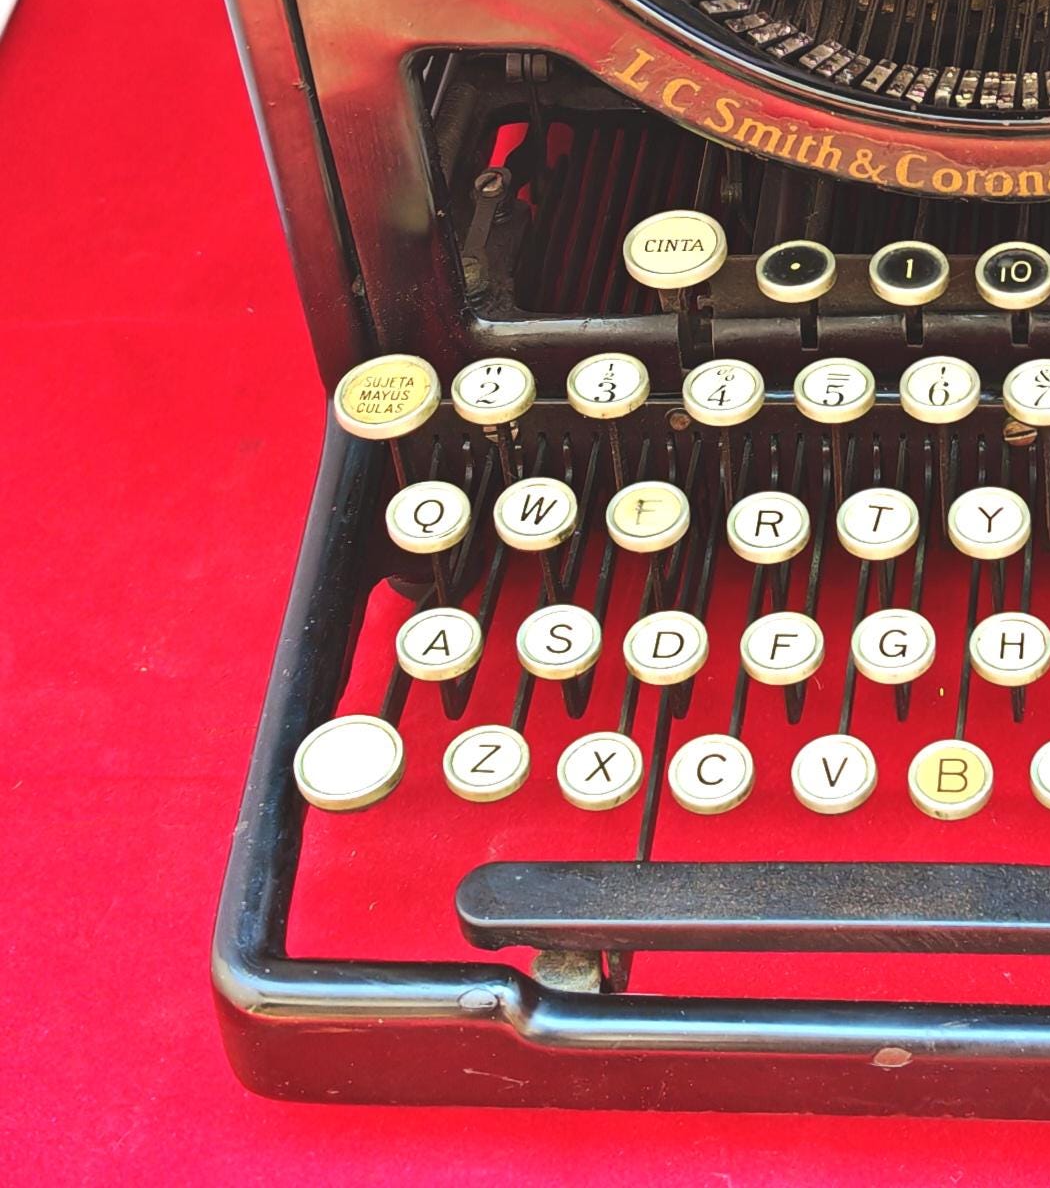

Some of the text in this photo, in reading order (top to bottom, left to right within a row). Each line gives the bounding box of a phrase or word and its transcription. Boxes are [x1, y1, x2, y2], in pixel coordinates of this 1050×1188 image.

[613, 47, 655, 93] L
[661, 77, 701, 113] C
[703, 97, 844, 173] Smith
[849, 148, 889, 186] &
[643, 238, 705, 254] CINTA
[904, 258, 914, 280] 1
[1000, 260, 1032, 283] 10
[359, 389, 411, 402] MAYUS
[364, 376, 415, 389] SUJETA
[475, 381, 500, 405] 2
[593, 381, 617, 404] 3
[707, 384, 732, 407] 4
[822, 384, 846, 406] 5
[927, 381, 950, 407] 6
[356, 402, 405, 414] CULAS
[413, 499, 445, 534] Q
[520, 493, 558, 526] W
[754, 509, 784, 538] R
[868, 504, 894, 533] T
[978, 506, 1004, 534] Y
[422, 629, 450, 657] A
[545, 623, 573, 654] S
[652, 631, 685, 659] D
[769, 633, 799, 661] F
[878, 629, 908, 658] G
[1000, 632, 1025, 660] H
[470, 744, 502, 774] Z
[584, 751, 617, 783] X
[696, 753, 727, 786] C
[821, 756, 848, 788] V
[936, 758, 969, 793] B
